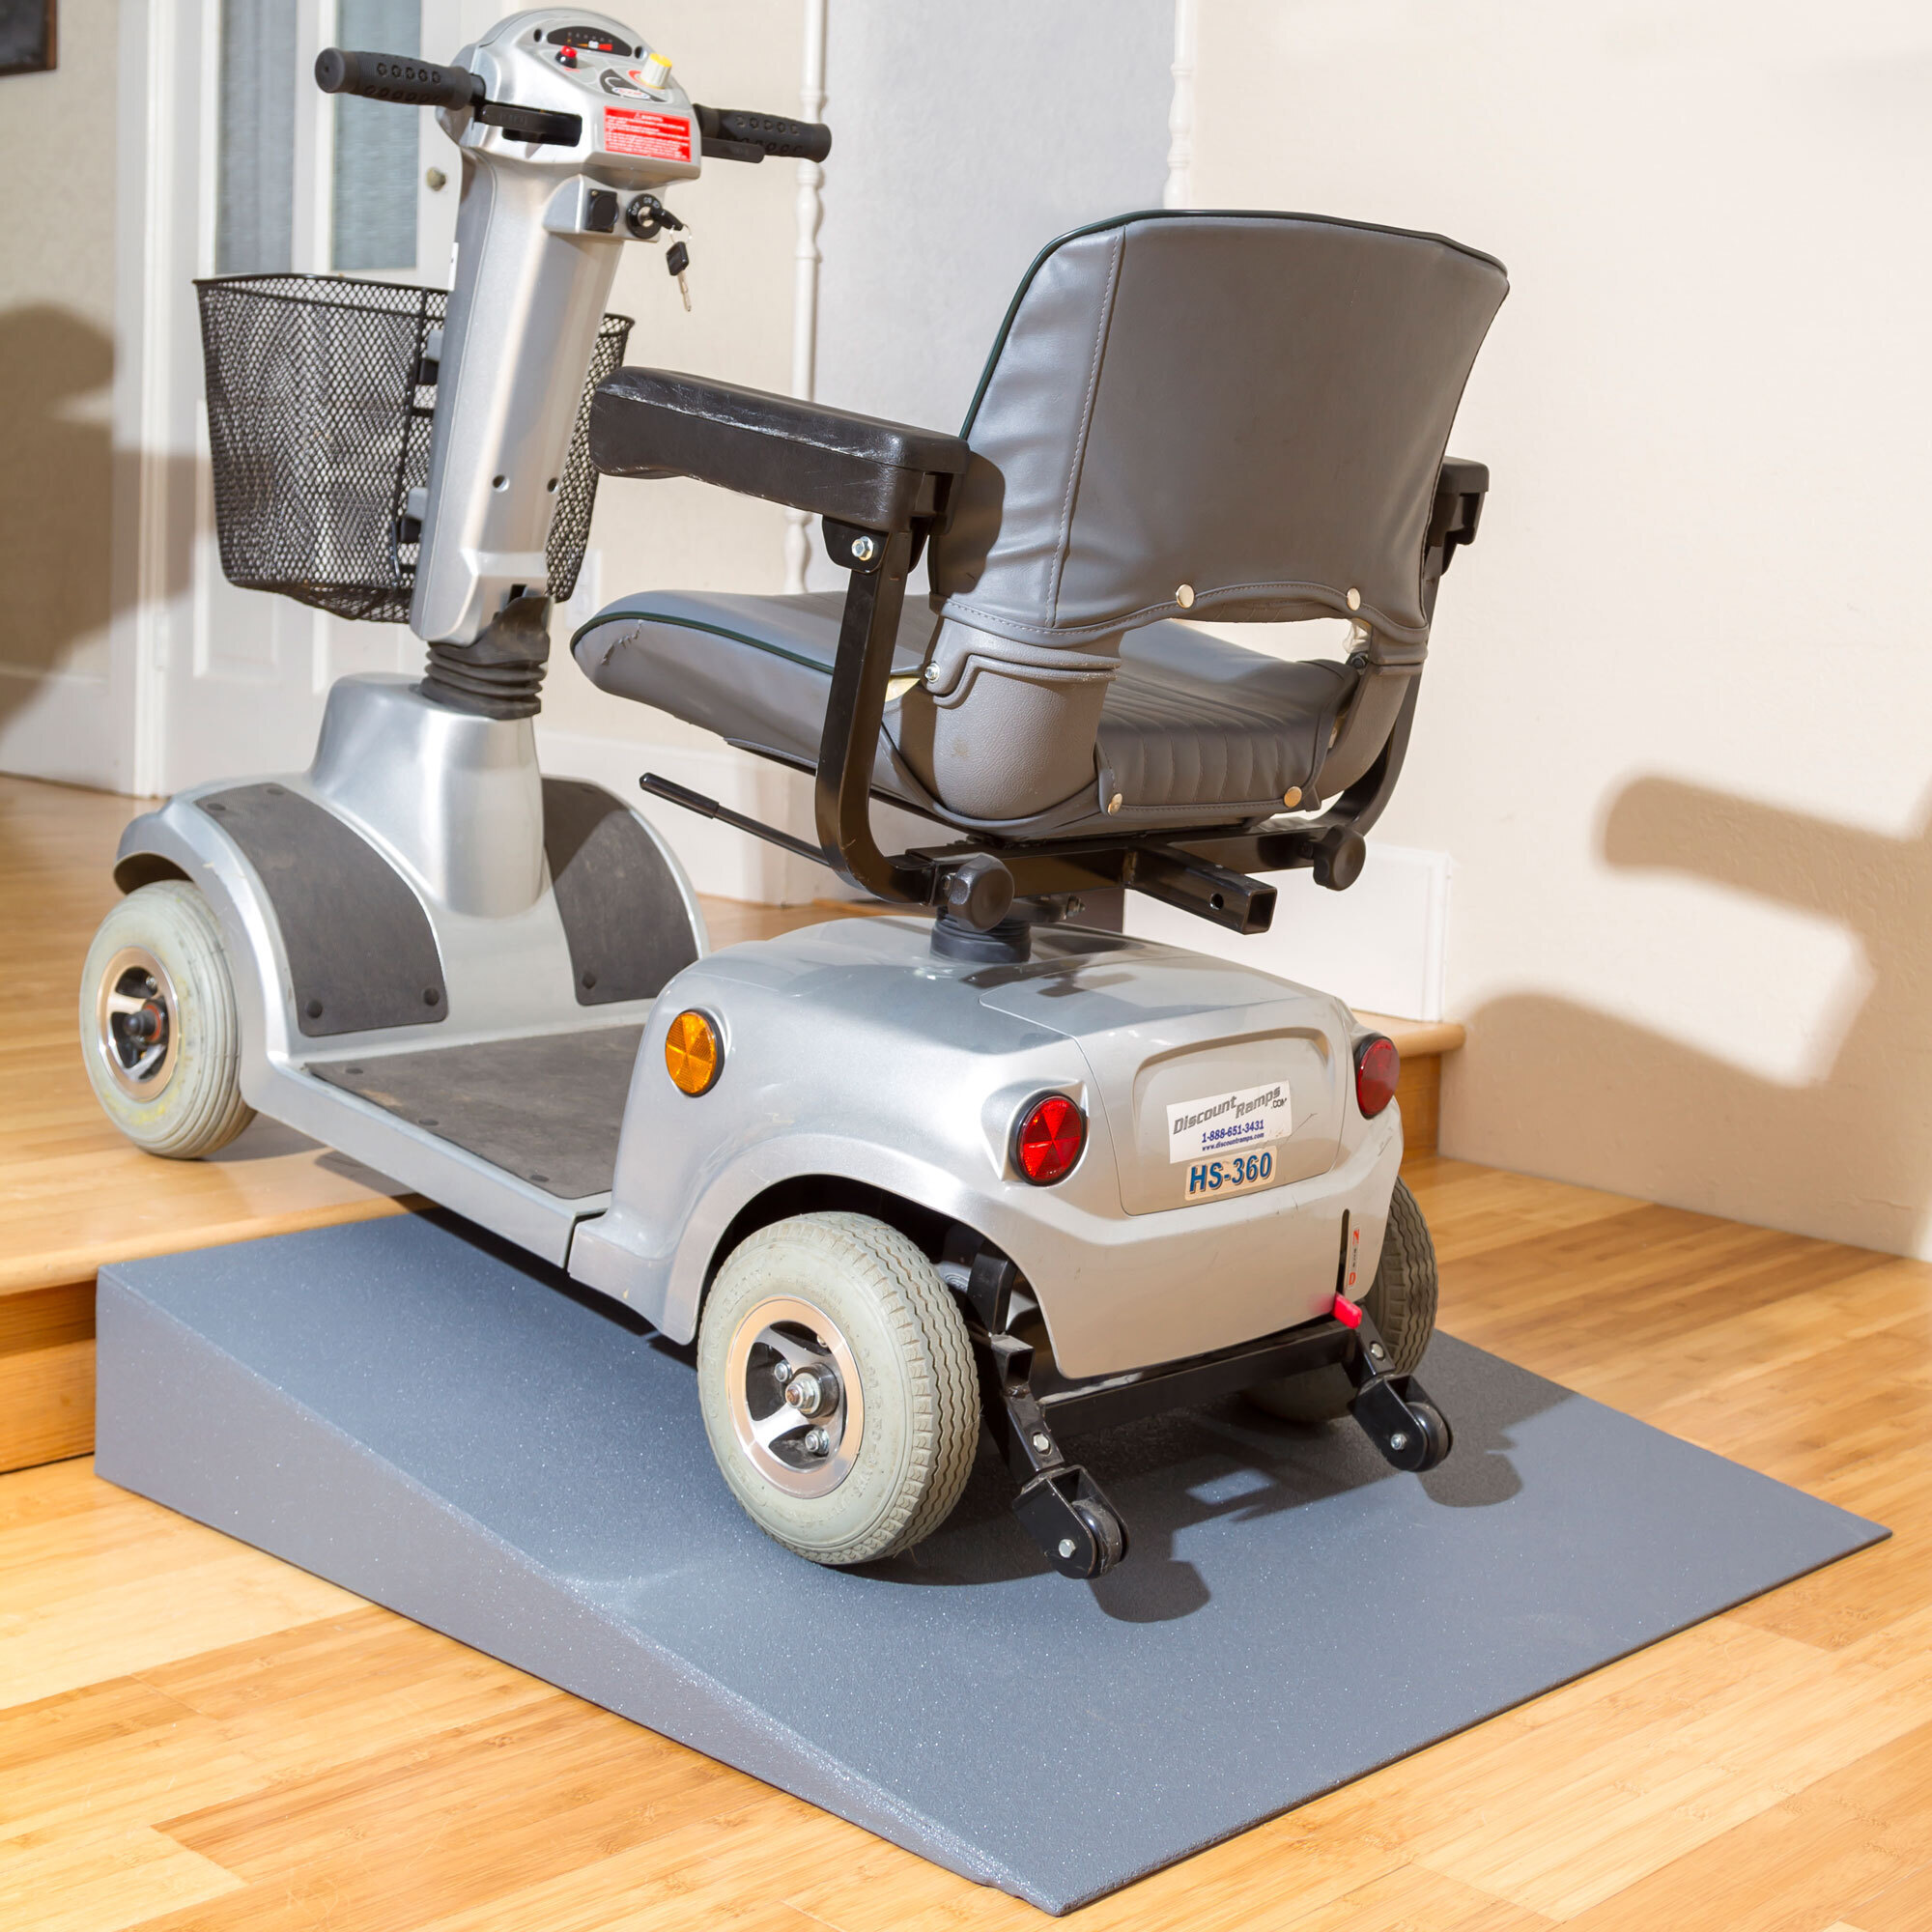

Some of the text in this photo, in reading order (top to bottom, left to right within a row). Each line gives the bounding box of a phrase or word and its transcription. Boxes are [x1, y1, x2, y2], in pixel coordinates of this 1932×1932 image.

[1173, 1095, 1236, 1135] Discount
[1236, 1086, 1281, 1119] Ramps
[1201, 1119, 1264, 1143] 1-888-651-3431
[1202, 1131, 1264, 1151] www.discountramps.com
[1189, 1151, 1271, 1194] HS-360
[1349, 1271, 1356, 1286] D
